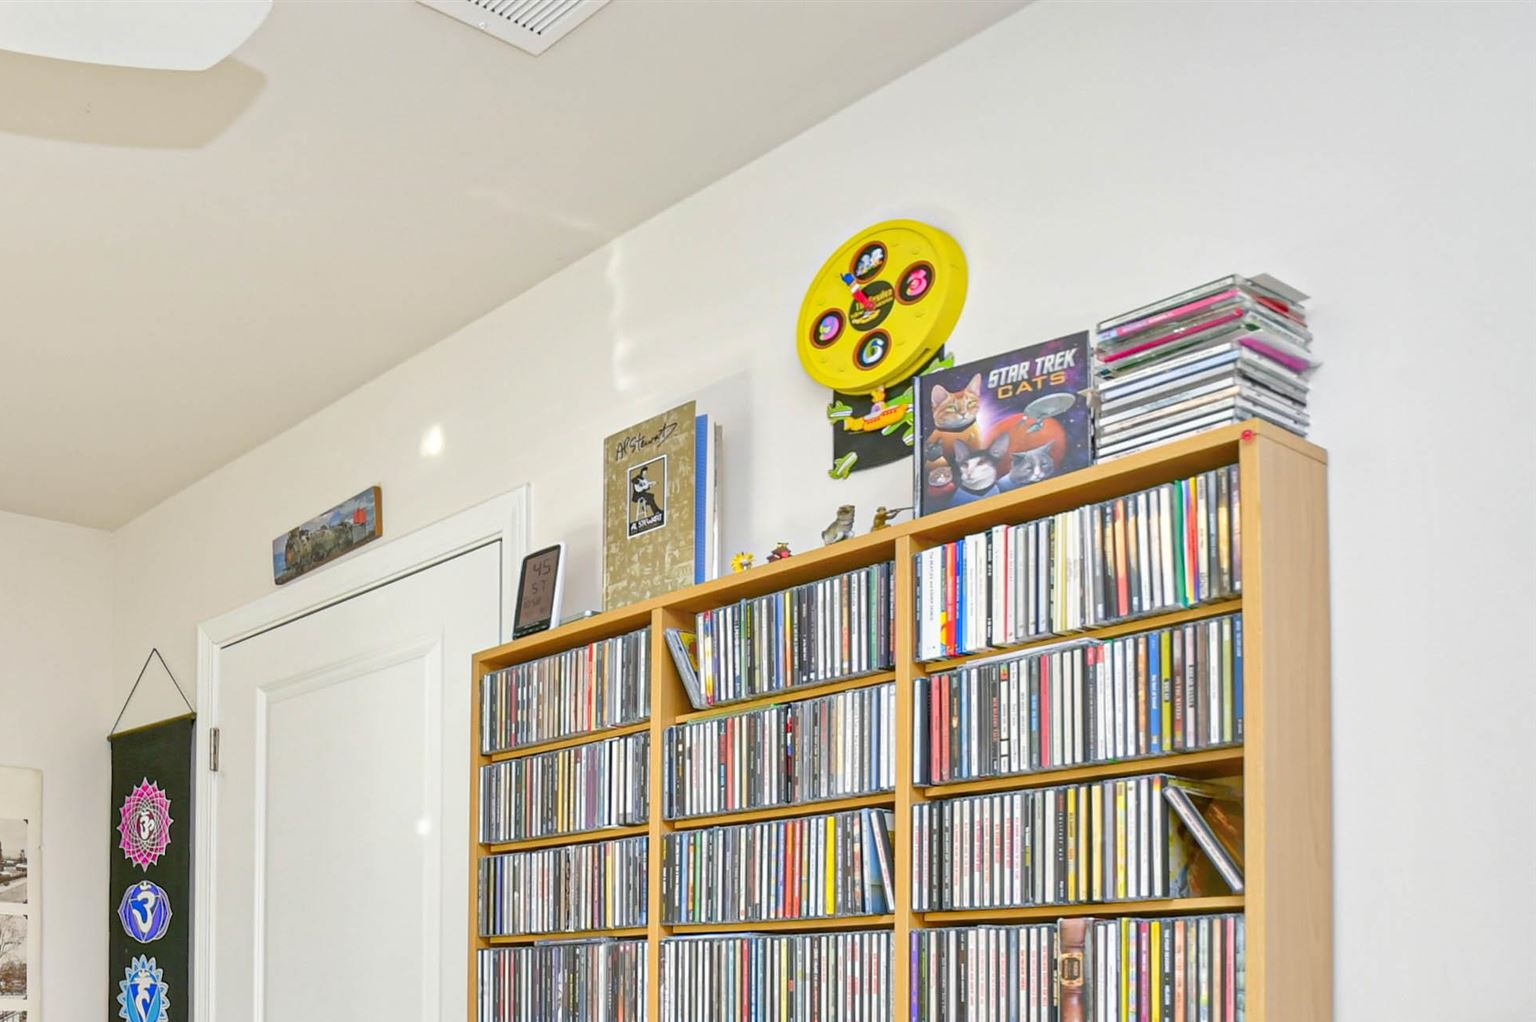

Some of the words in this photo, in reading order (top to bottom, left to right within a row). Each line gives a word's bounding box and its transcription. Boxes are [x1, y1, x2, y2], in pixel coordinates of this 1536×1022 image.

[862, 338, 885, 364] 6
[988, 356, 1030, 388] STAR
[1034, 346, 1077, 377] TREK
[997, 371, 1066, 400] CATS
